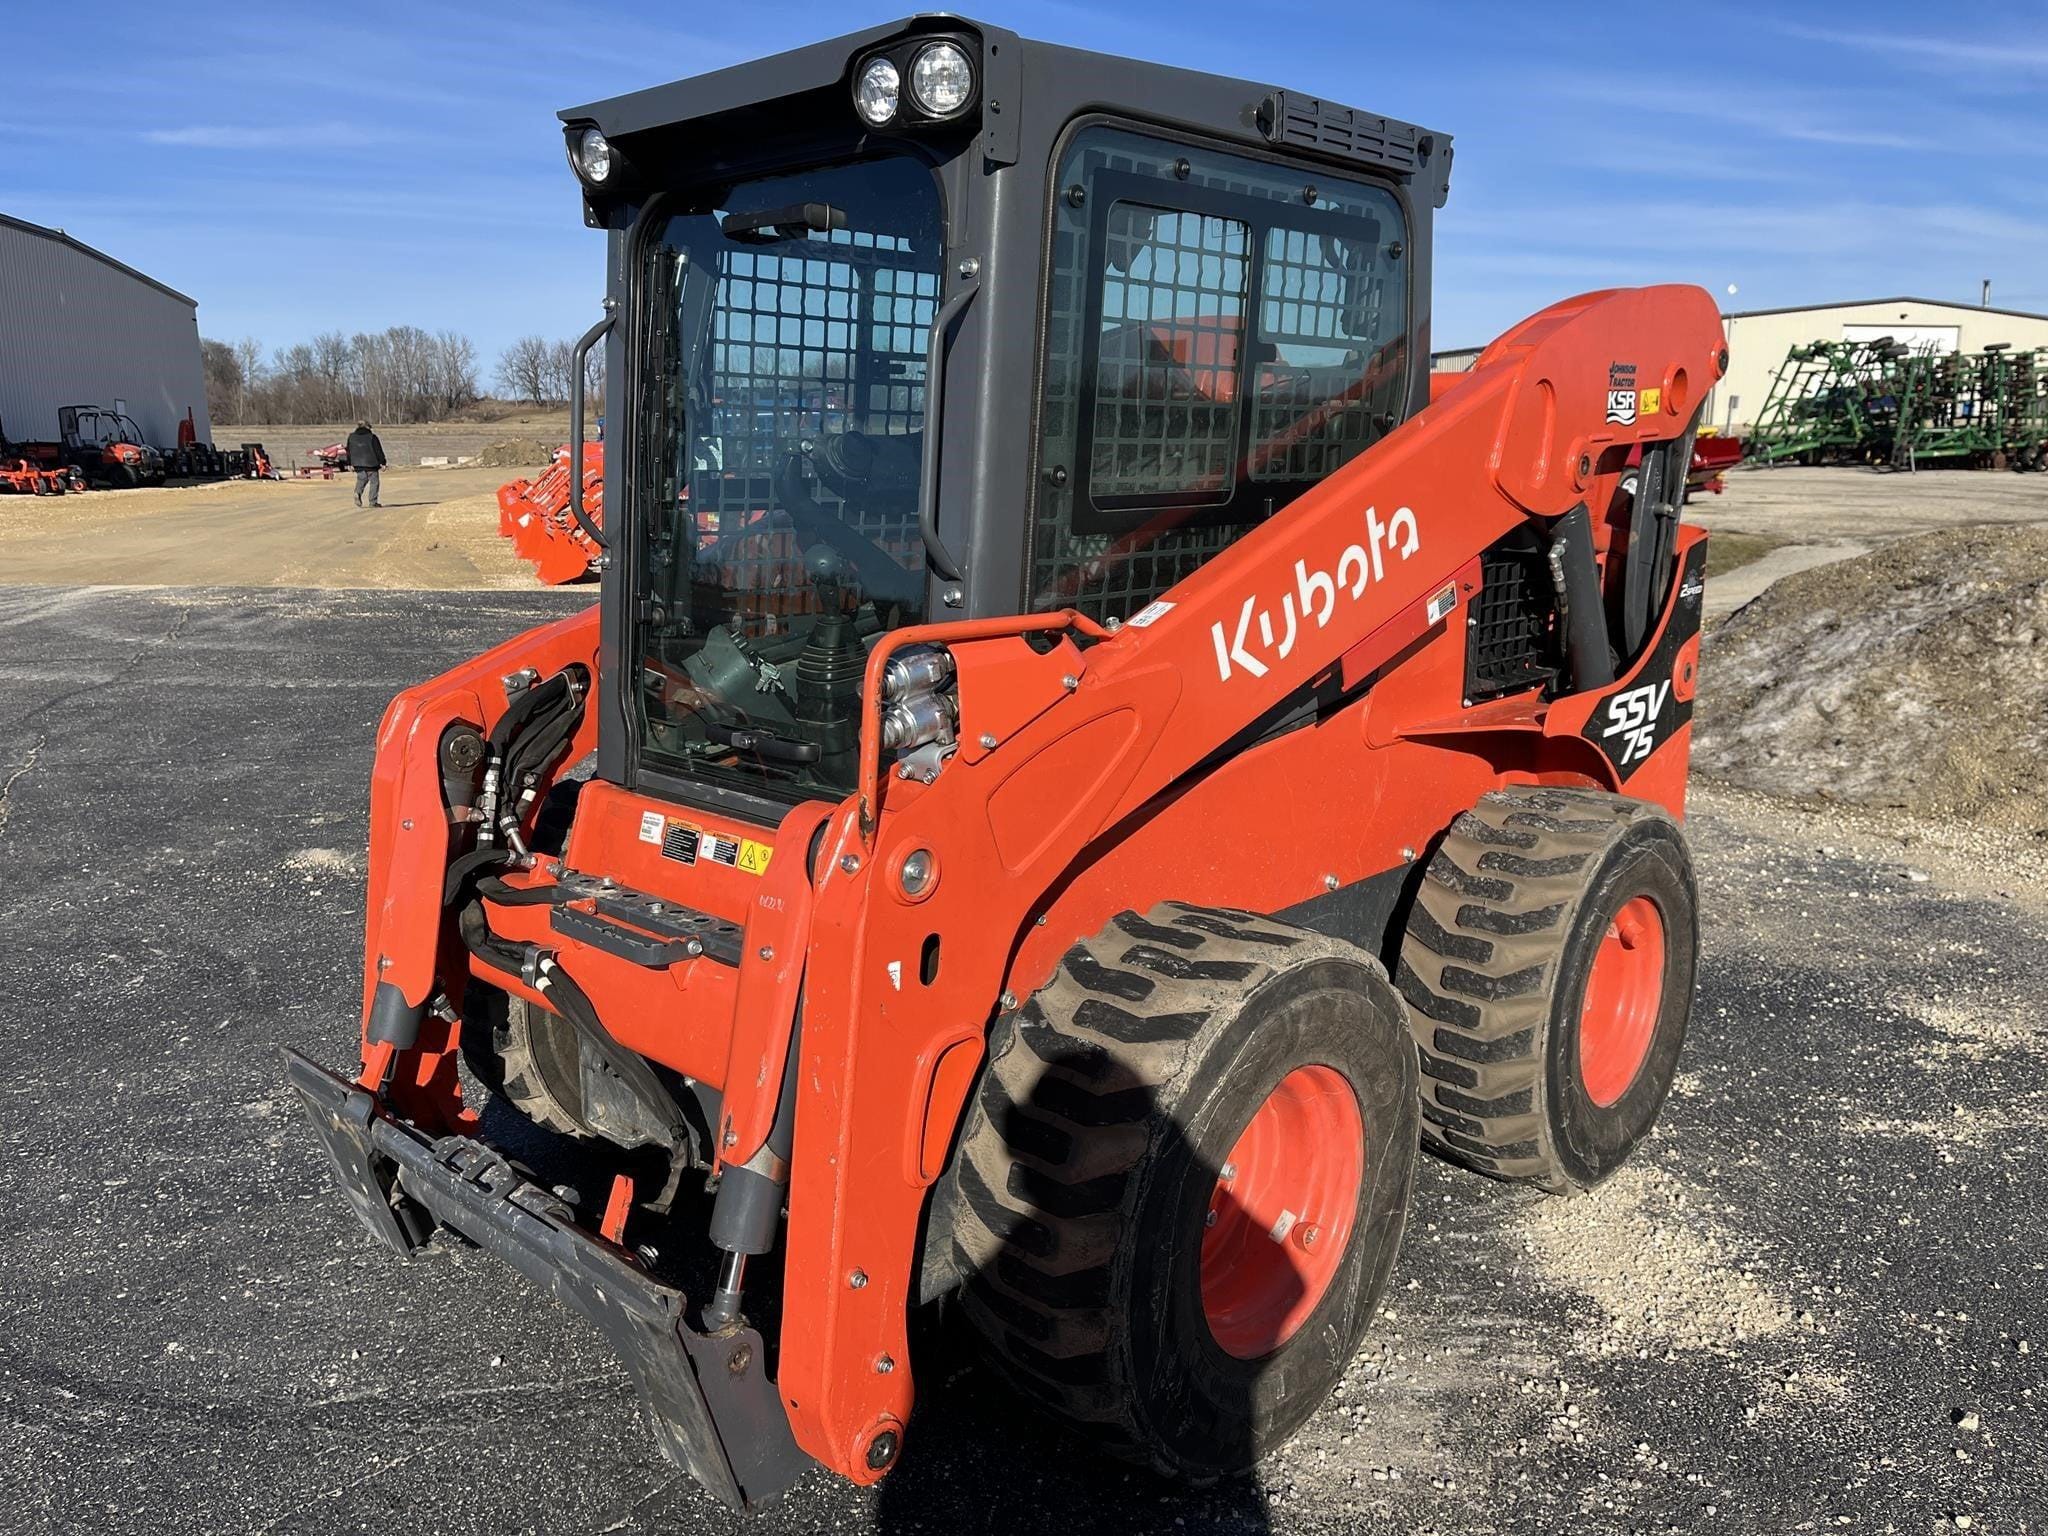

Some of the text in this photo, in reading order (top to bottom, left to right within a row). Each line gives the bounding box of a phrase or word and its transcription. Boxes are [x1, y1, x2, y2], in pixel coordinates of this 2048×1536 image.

[1608, 390, 1635, 409] KSR
[1211, 505, 1420, 682] Kubota
[1603, 679, 1671, 738] SSV
[1621, 723, 1656, 765] 75
